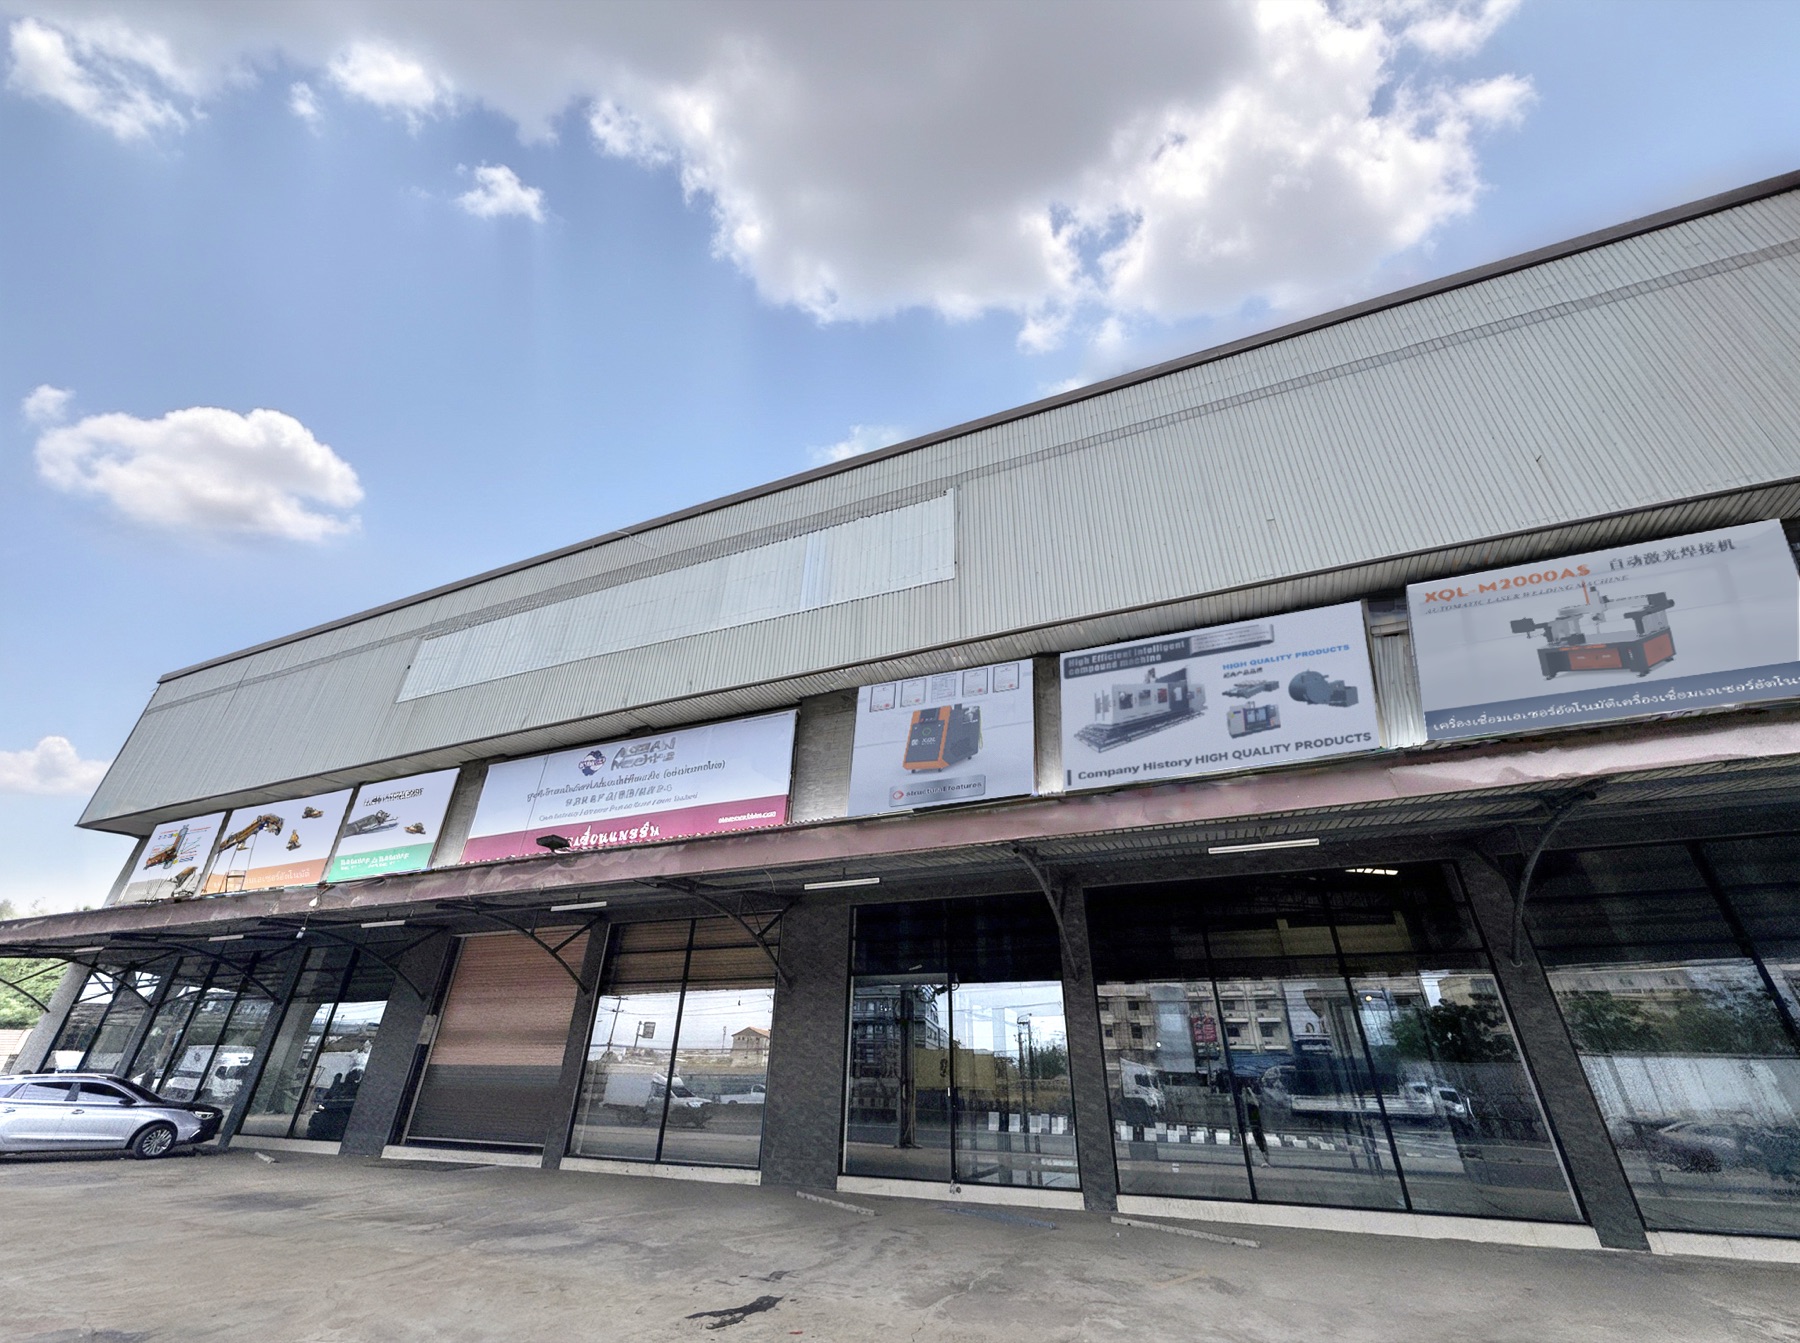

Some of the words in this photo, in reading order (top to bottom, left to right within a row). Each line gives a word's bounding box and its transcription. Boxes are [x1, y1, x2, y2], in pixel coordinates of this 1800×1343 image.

[1425, 564, 1591, 603] XQL-M2000AS
[1068, 656, 1090, 668] High
[1092, 650, 1132, 664] Efficient
[1222, 661, 1247, 671] HIGH
[1249, 653, 1292, 666] QUALITY
[1295, 643, 1350, 659] PRODUCTS
[1078, 765, 1140, 780] Company
[1143, 757, 1193, 771] History
[1195, 751, 1228, 765] HIGH
[1232, 743, 1291, 760] QUALITY
[1295, 732, 1372, 751] PRODUCTS
